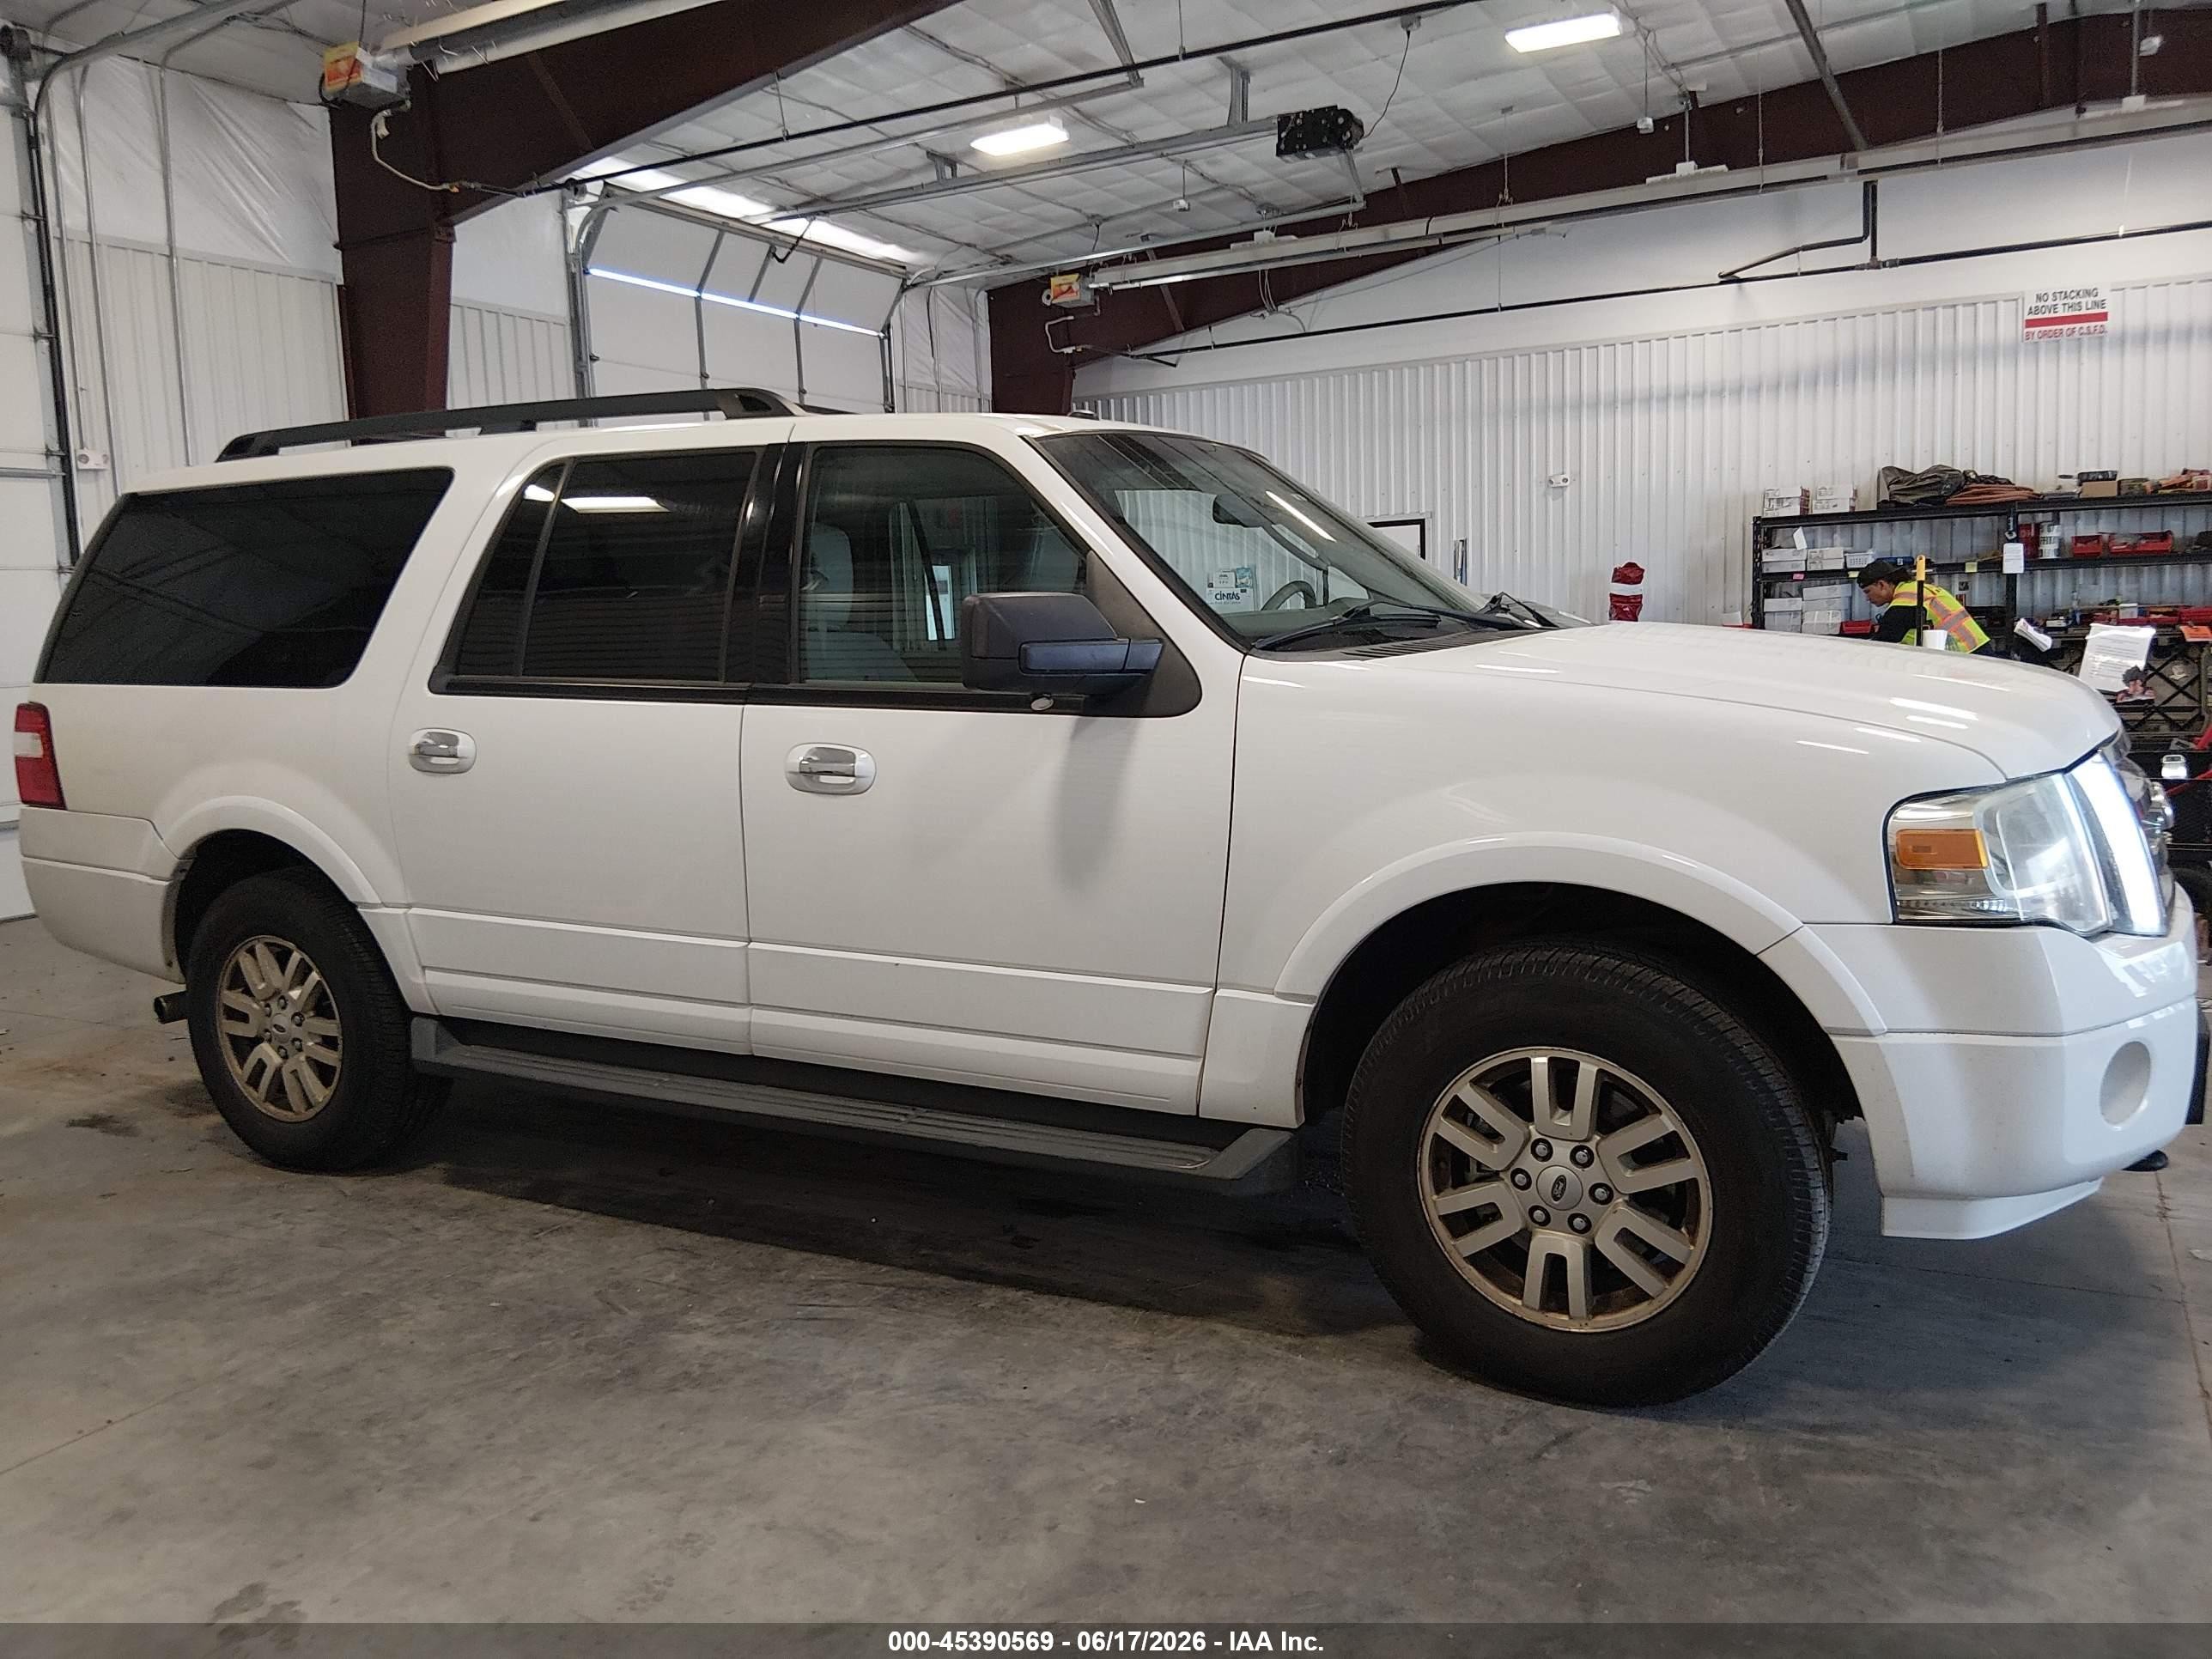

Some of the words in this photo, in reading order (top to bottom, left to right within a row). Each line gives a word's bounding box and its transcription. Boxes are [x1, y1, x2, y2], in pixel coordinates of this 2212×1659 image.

[2035, 292, 2049, 303] NO
[2051, 288, 2099, 302] STACKING
[2027, 303, 2058, 316] ABOVE
[2062, 301, 2082, 313] THIS
[2085, 299, 2106, 311] LINE
[2025, 331, 2035, 341] BY
[2037, 328, 2063, 339] ORDER
[2065, 327, 2076, 337] OF
